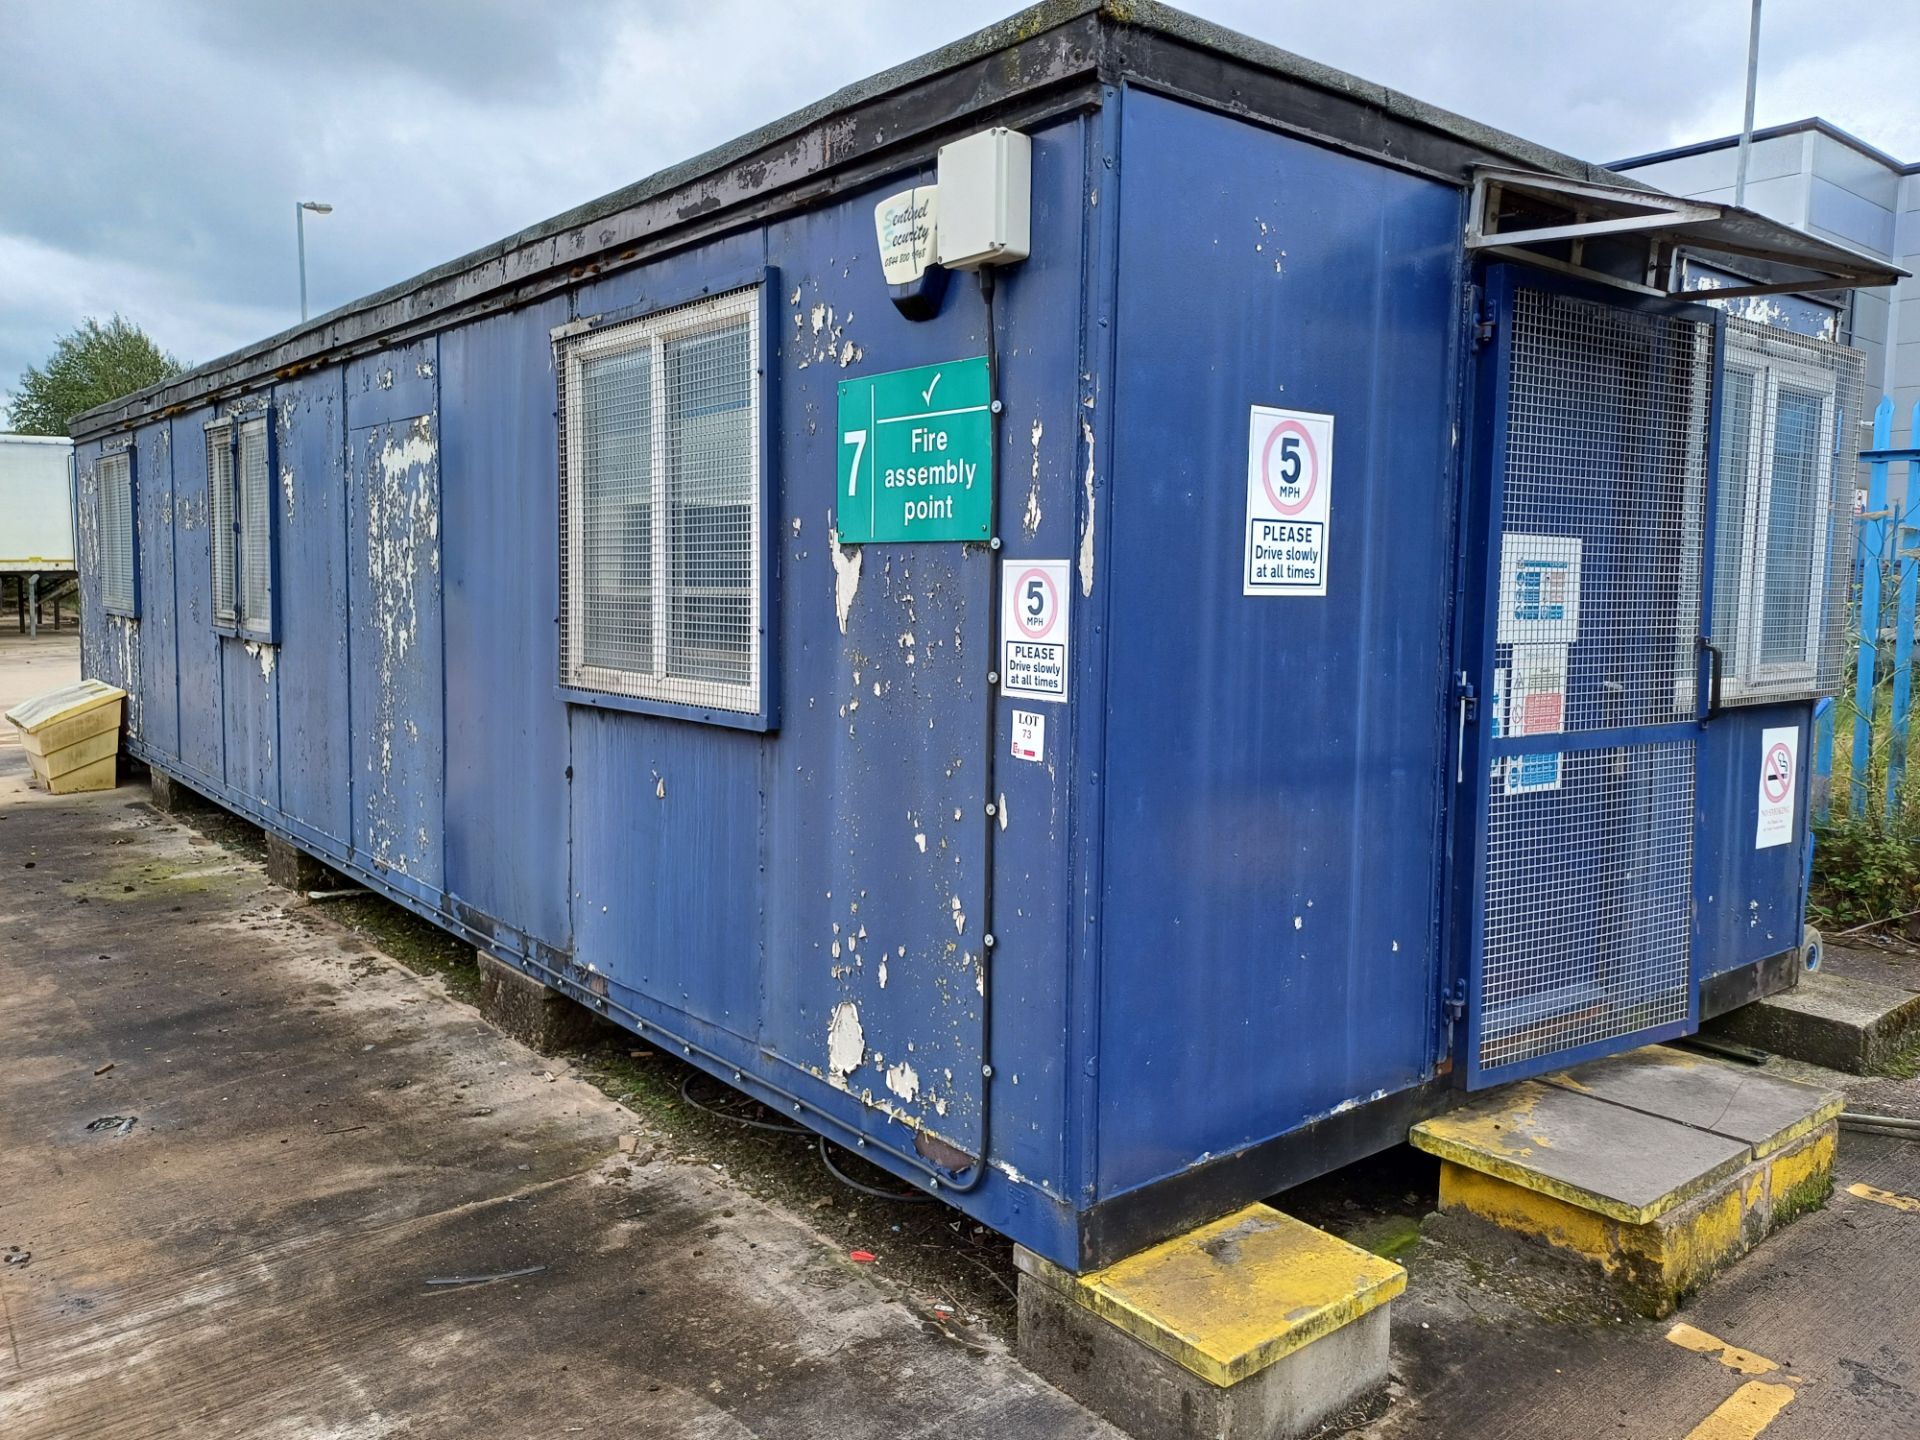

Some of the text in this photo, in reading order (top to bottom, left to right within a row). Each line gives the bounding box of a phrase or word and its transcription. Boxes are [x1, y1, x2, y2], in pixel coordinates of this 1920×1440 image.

[884, 198, 929, 230] Sentinel
[884, 224, 929, 251] Security
[911, 428, 948, 453] Fire
[844, 429, 867, 496] 7
[1281, 437, 1301, 484] 5
[884, 458, 977, 490] assembly
[1279, 485, 1300, 499] MPH
[904, 495, 953, 527] point
[1263, 525, 1312, 543] PLEASE
[1255, 544, 1319, 564] Drive slowly
[1256, 563, 1315, 579] at all times
[1027, 581, 1044, 616] 5
[1026, 616, 1044, 627] MPH
[1015, 645, 1055, 660] PLEASE
[1009, 659, 1061, 677] Drive slowly
[1010, 673, 1058, 688] at all times
[1018, 712, 1040, 727] LOT
[1022, 728, 1032, 740] 73
